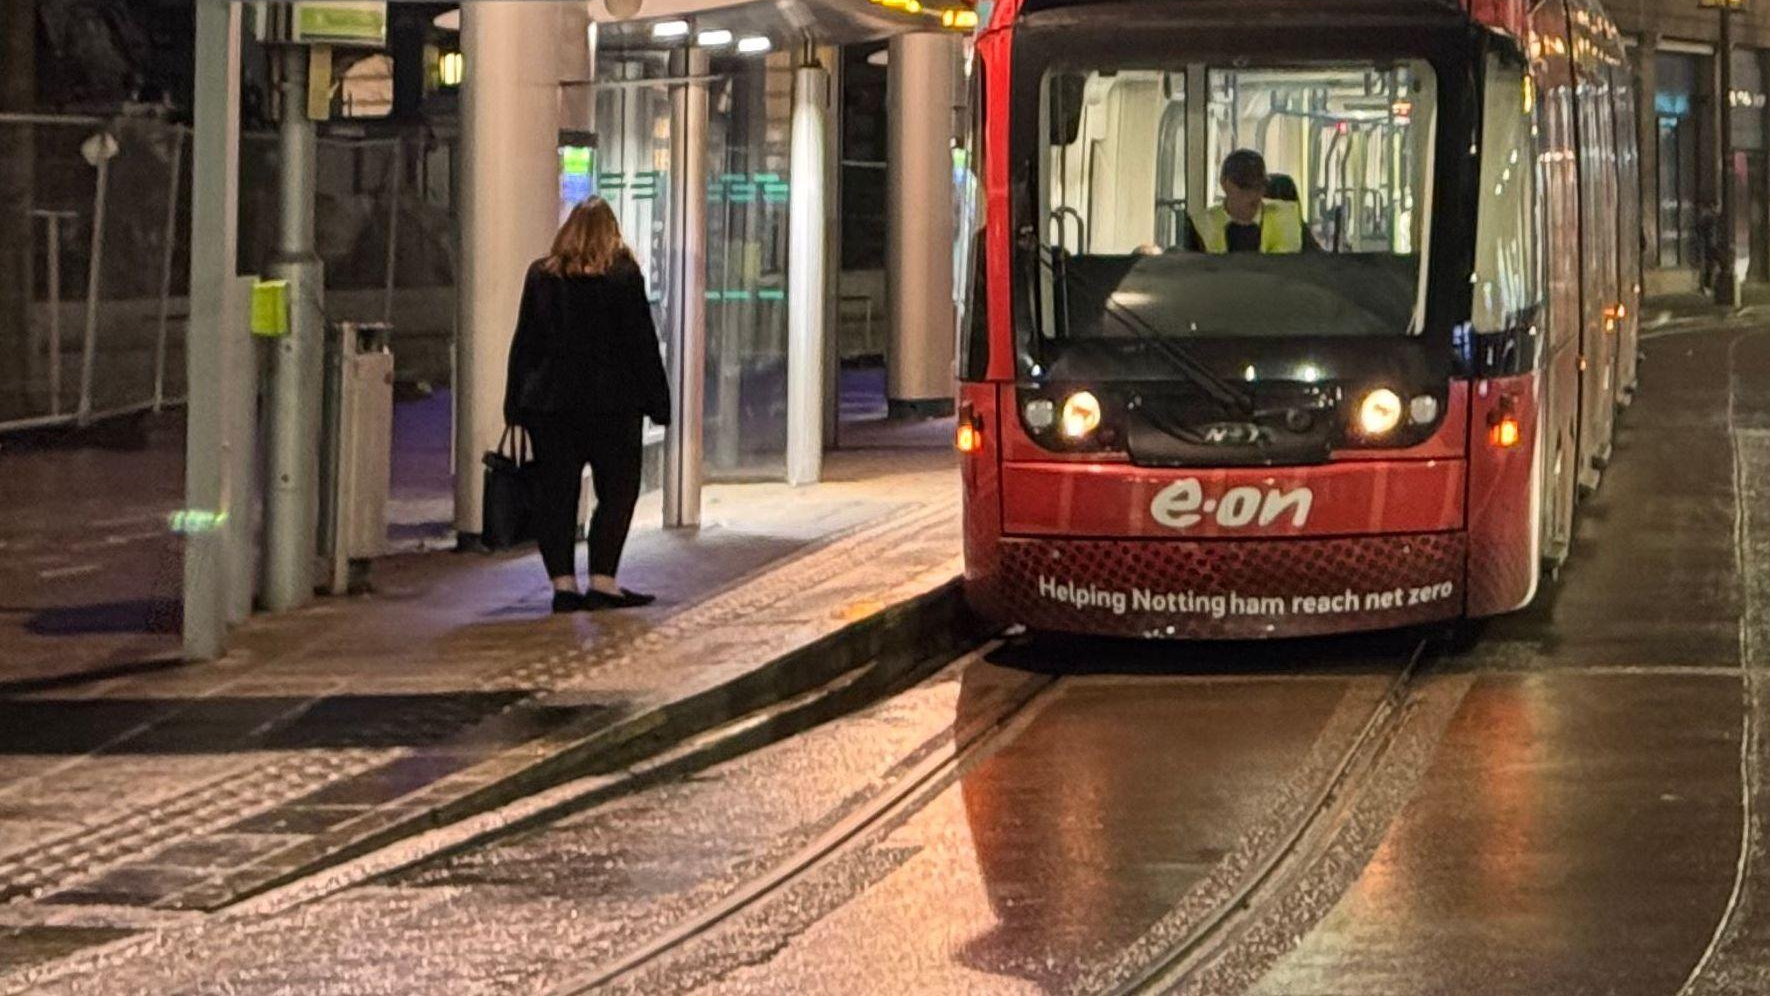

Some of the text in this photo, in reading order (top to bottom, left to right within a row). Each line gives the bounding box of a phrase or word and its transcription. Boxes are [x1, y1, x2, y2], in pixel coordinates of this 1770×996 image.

[1039, 574, 1126, 615] Helping
[1291, 589, 1360, 614] reach
[1364, 587, 1403, 611] net
[1407, 580, 1454, 605] zero
